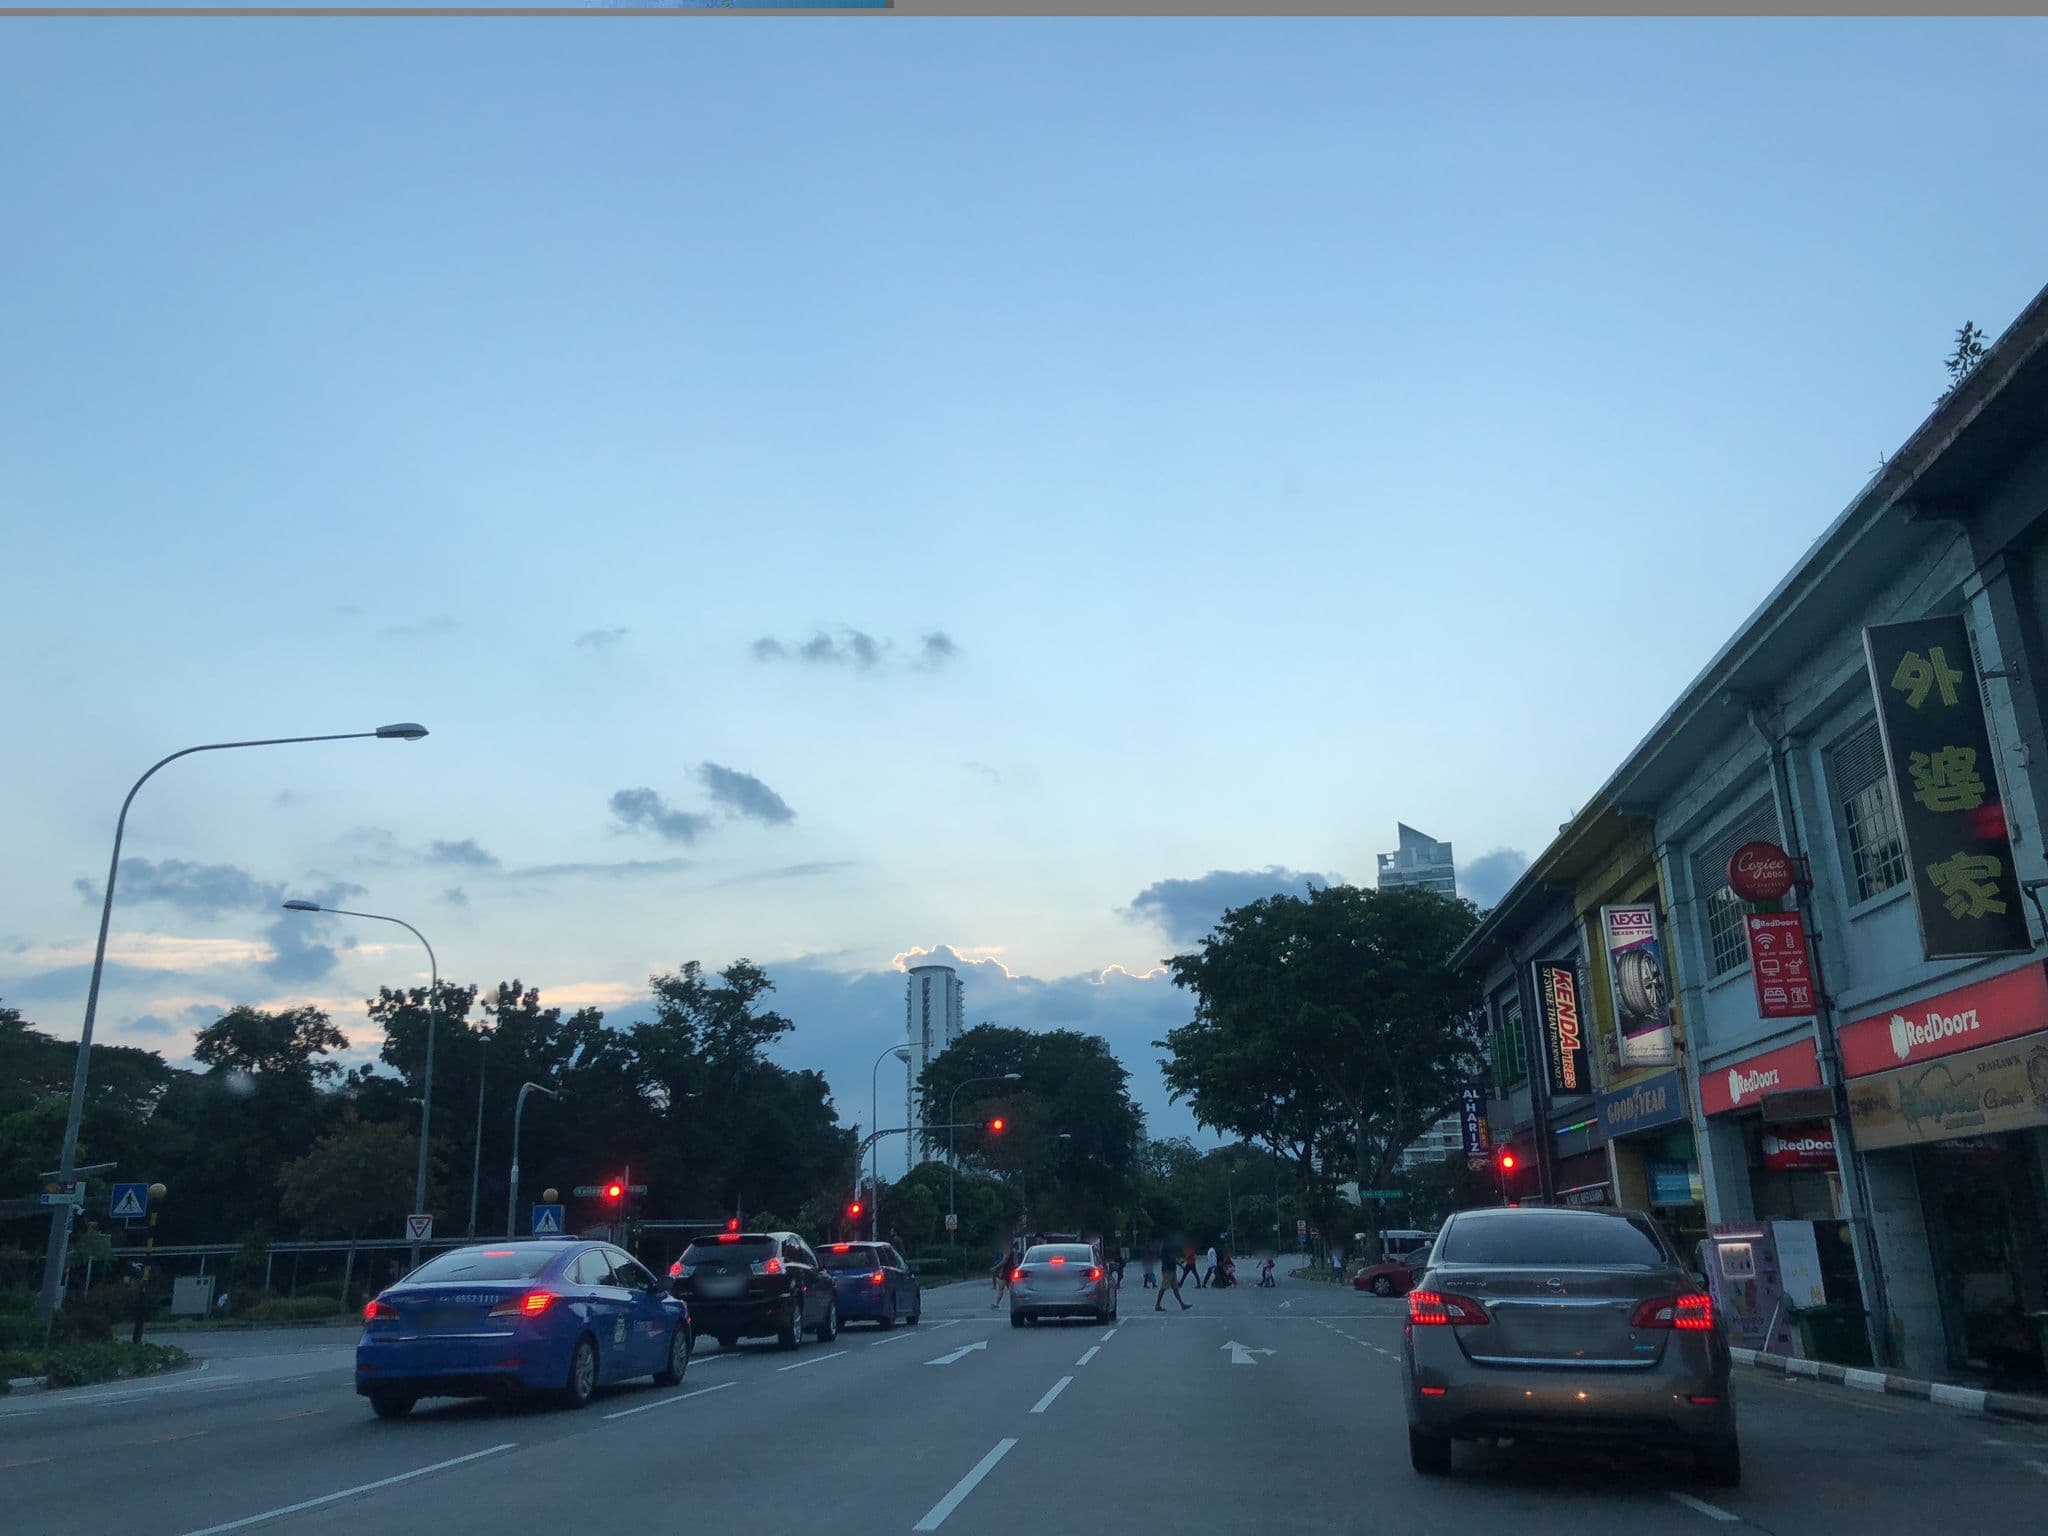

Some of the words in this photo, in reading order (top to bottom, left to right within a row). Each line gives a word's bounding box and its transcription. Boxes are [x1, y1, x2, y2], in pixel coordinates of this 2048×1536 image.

[1610, 913, 1651, 925] NEXEN
[1552, 966, 1581, 1049] KENDA
[1906, 1009, 1980, 1046] RedDoorz
[1562, 1048, 1577, 1089] TIRES
[1737, 1069, 1779, 1094] RedDoorz
[1466, 1103, 1480, 1152] HARIZ
[1779, 1138, 1833, 1151] RedDoo
